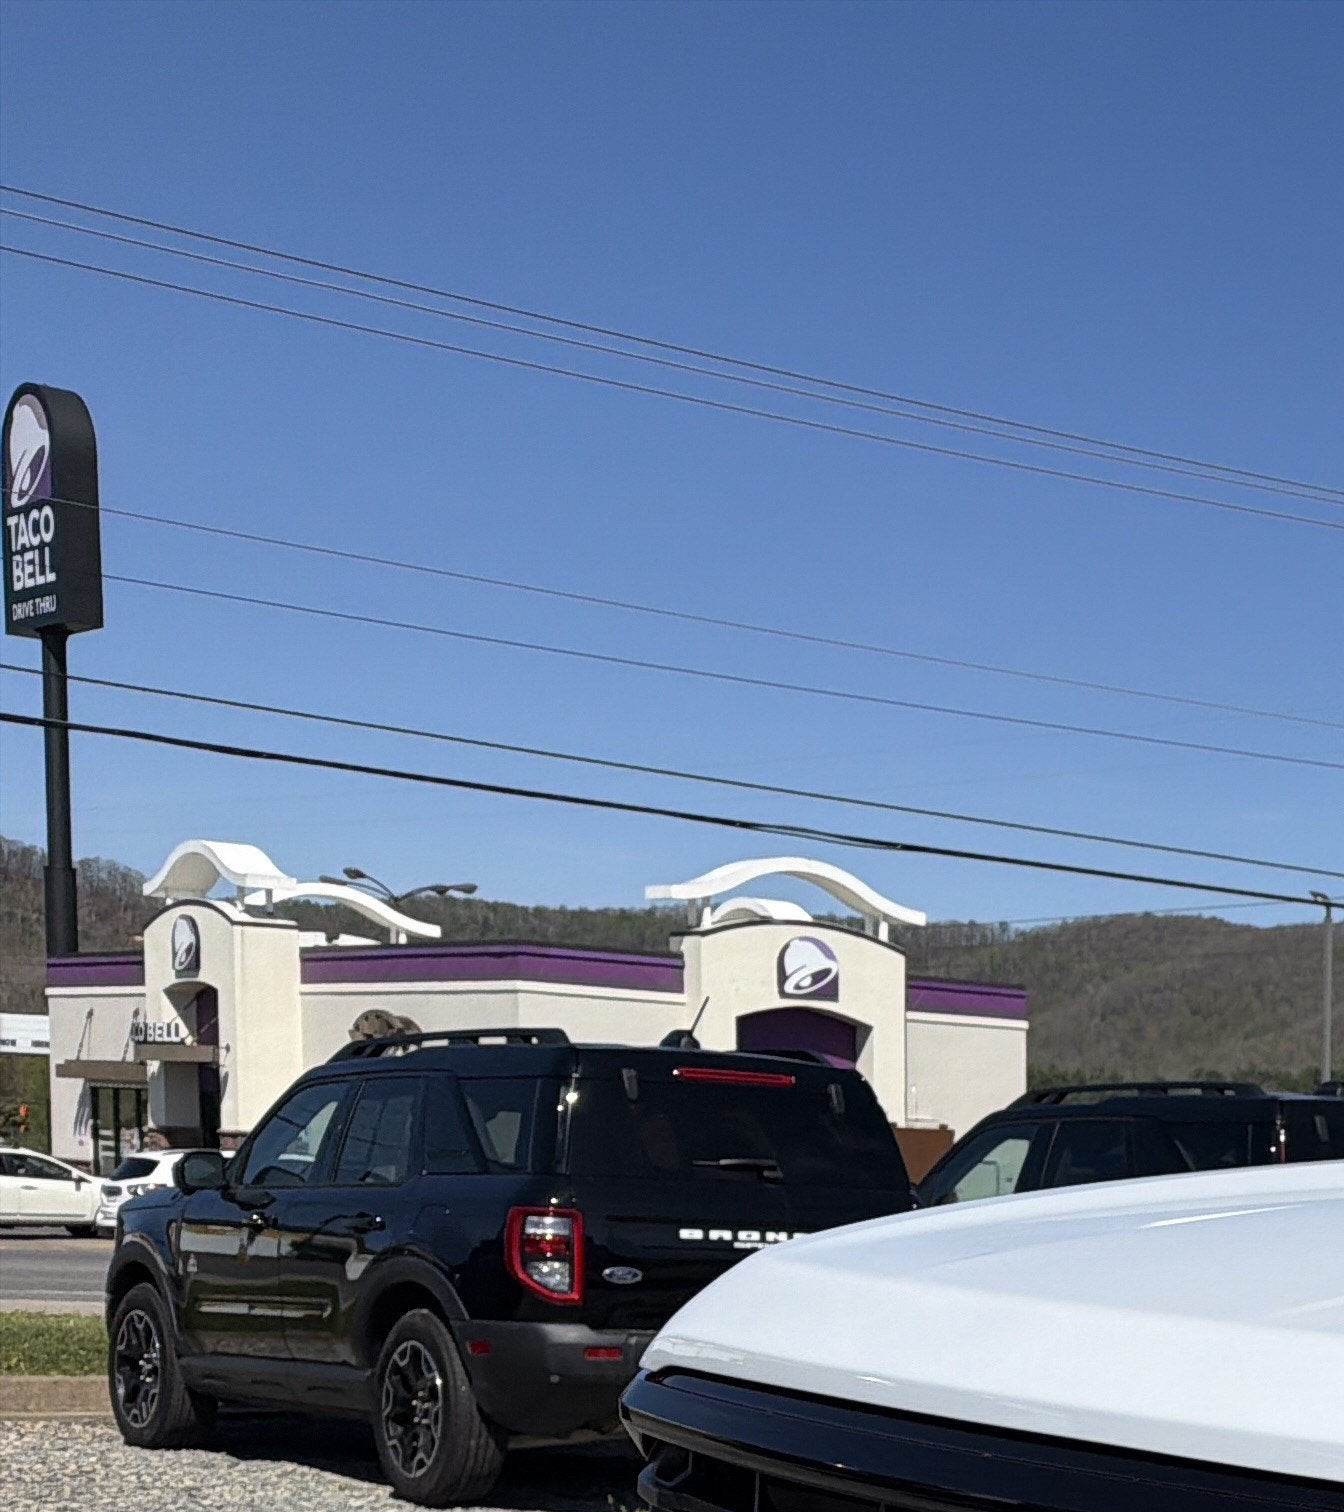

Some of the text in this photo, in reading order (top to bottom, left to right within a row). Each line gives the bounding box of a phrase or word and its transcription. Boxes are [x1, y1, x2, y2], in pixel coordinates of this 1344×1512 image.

[7, 505, 55, 552] TACO
[12, 546, 57, 592] BELL
[12, 594, 57, 621] DRIVE THRU
[147, 1021, 182, 1042] BELL
